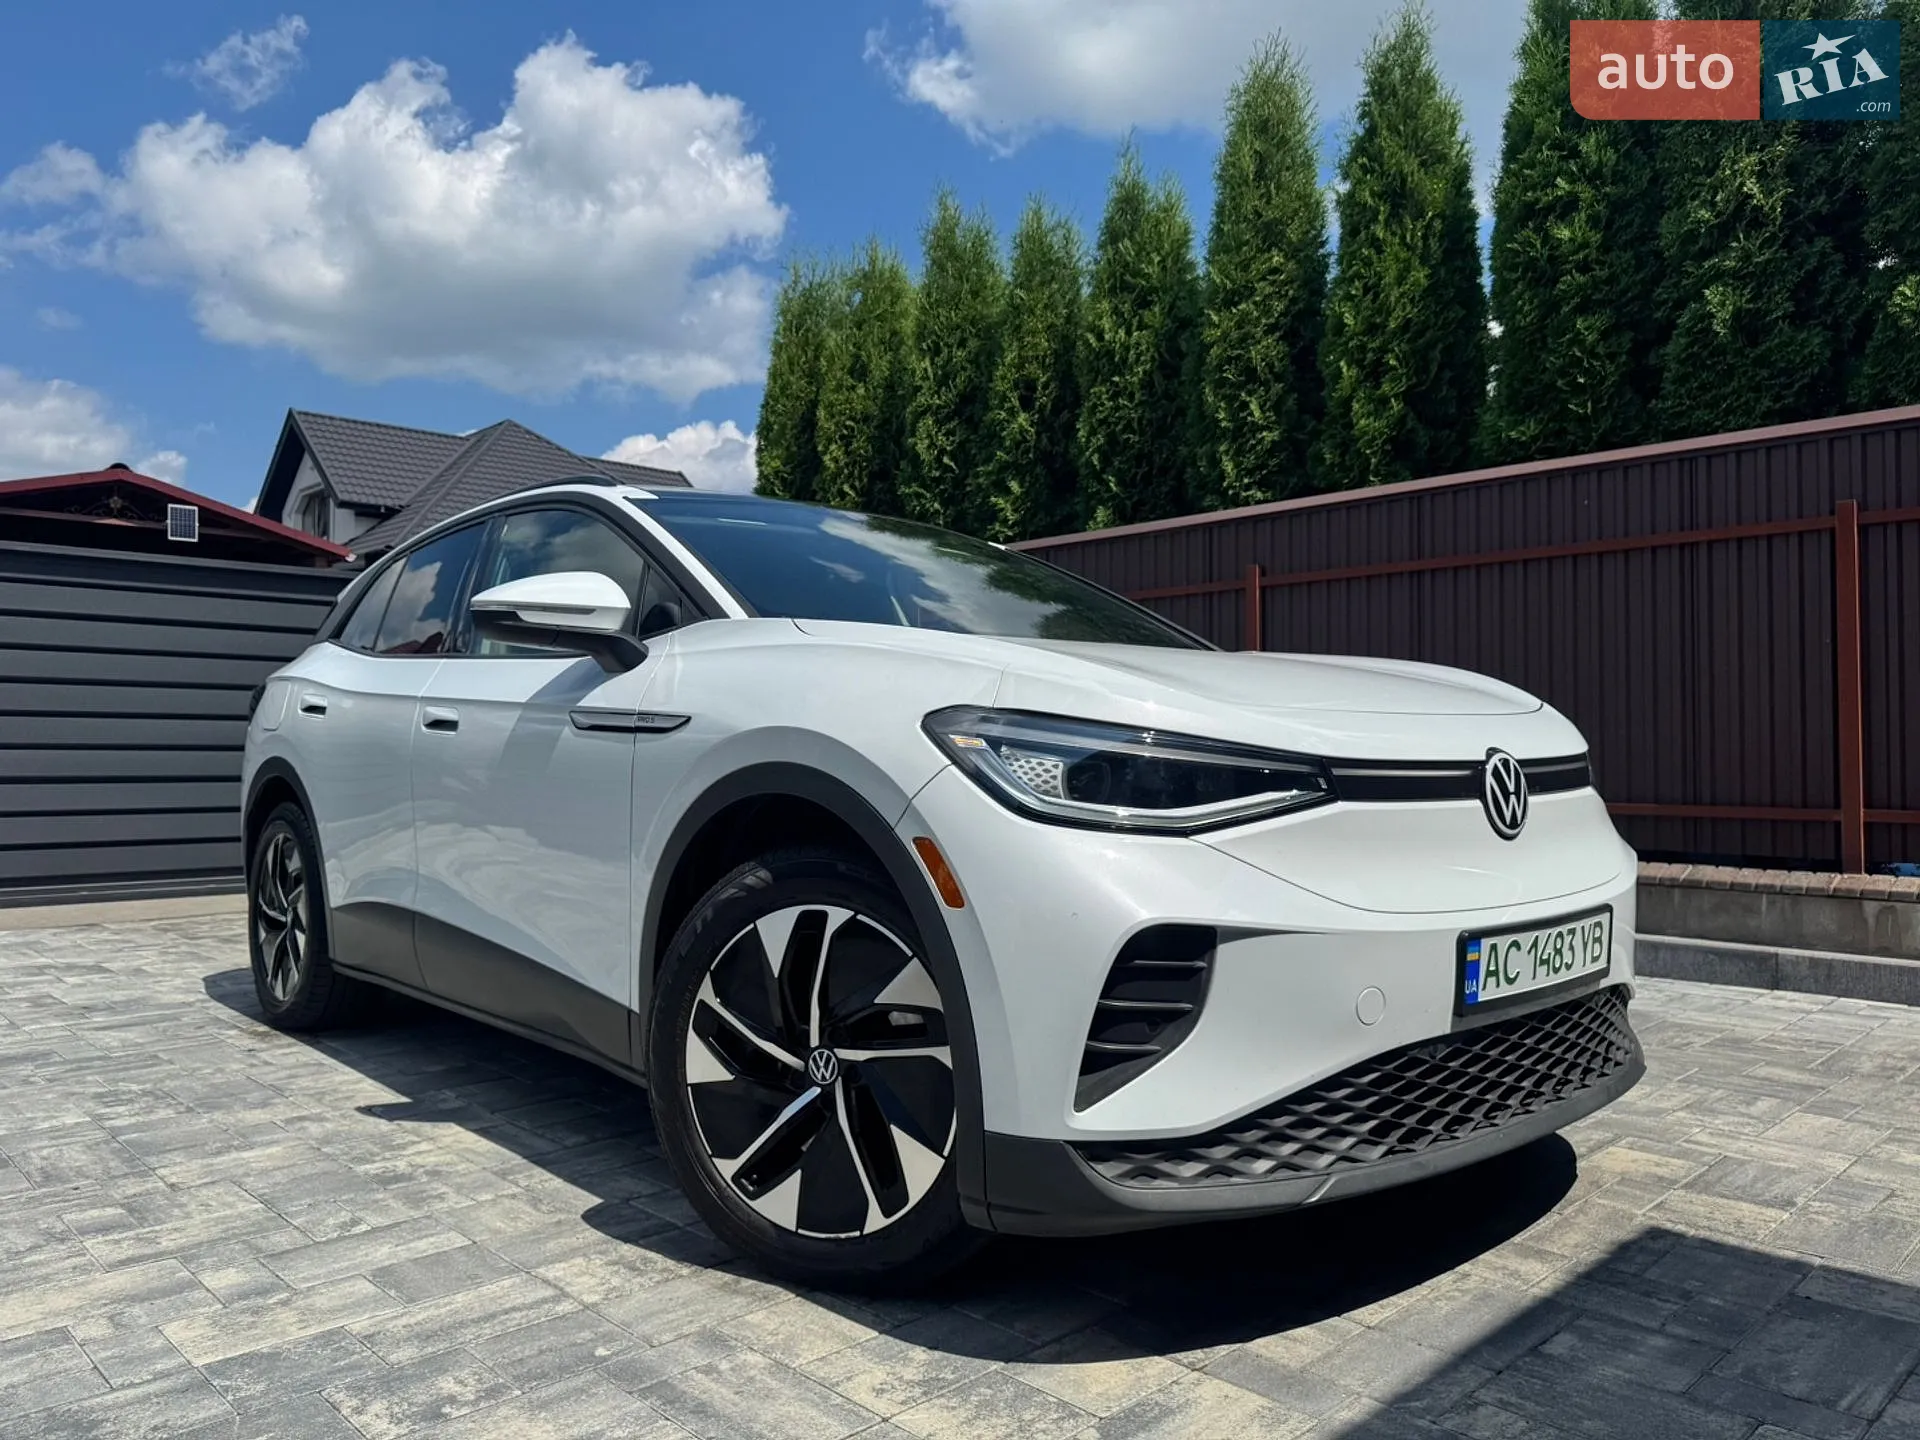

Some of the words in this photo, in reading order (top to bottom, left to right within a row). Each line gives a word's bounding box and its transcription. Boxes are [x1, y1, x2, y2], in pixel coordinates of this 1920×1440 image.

[1482, 939, 1522, 991] AC
[1527, 927, 1577, 980] 1483
[1580, 920, 1604, 968] YB
[1465, 979, 1478, 994] UA
